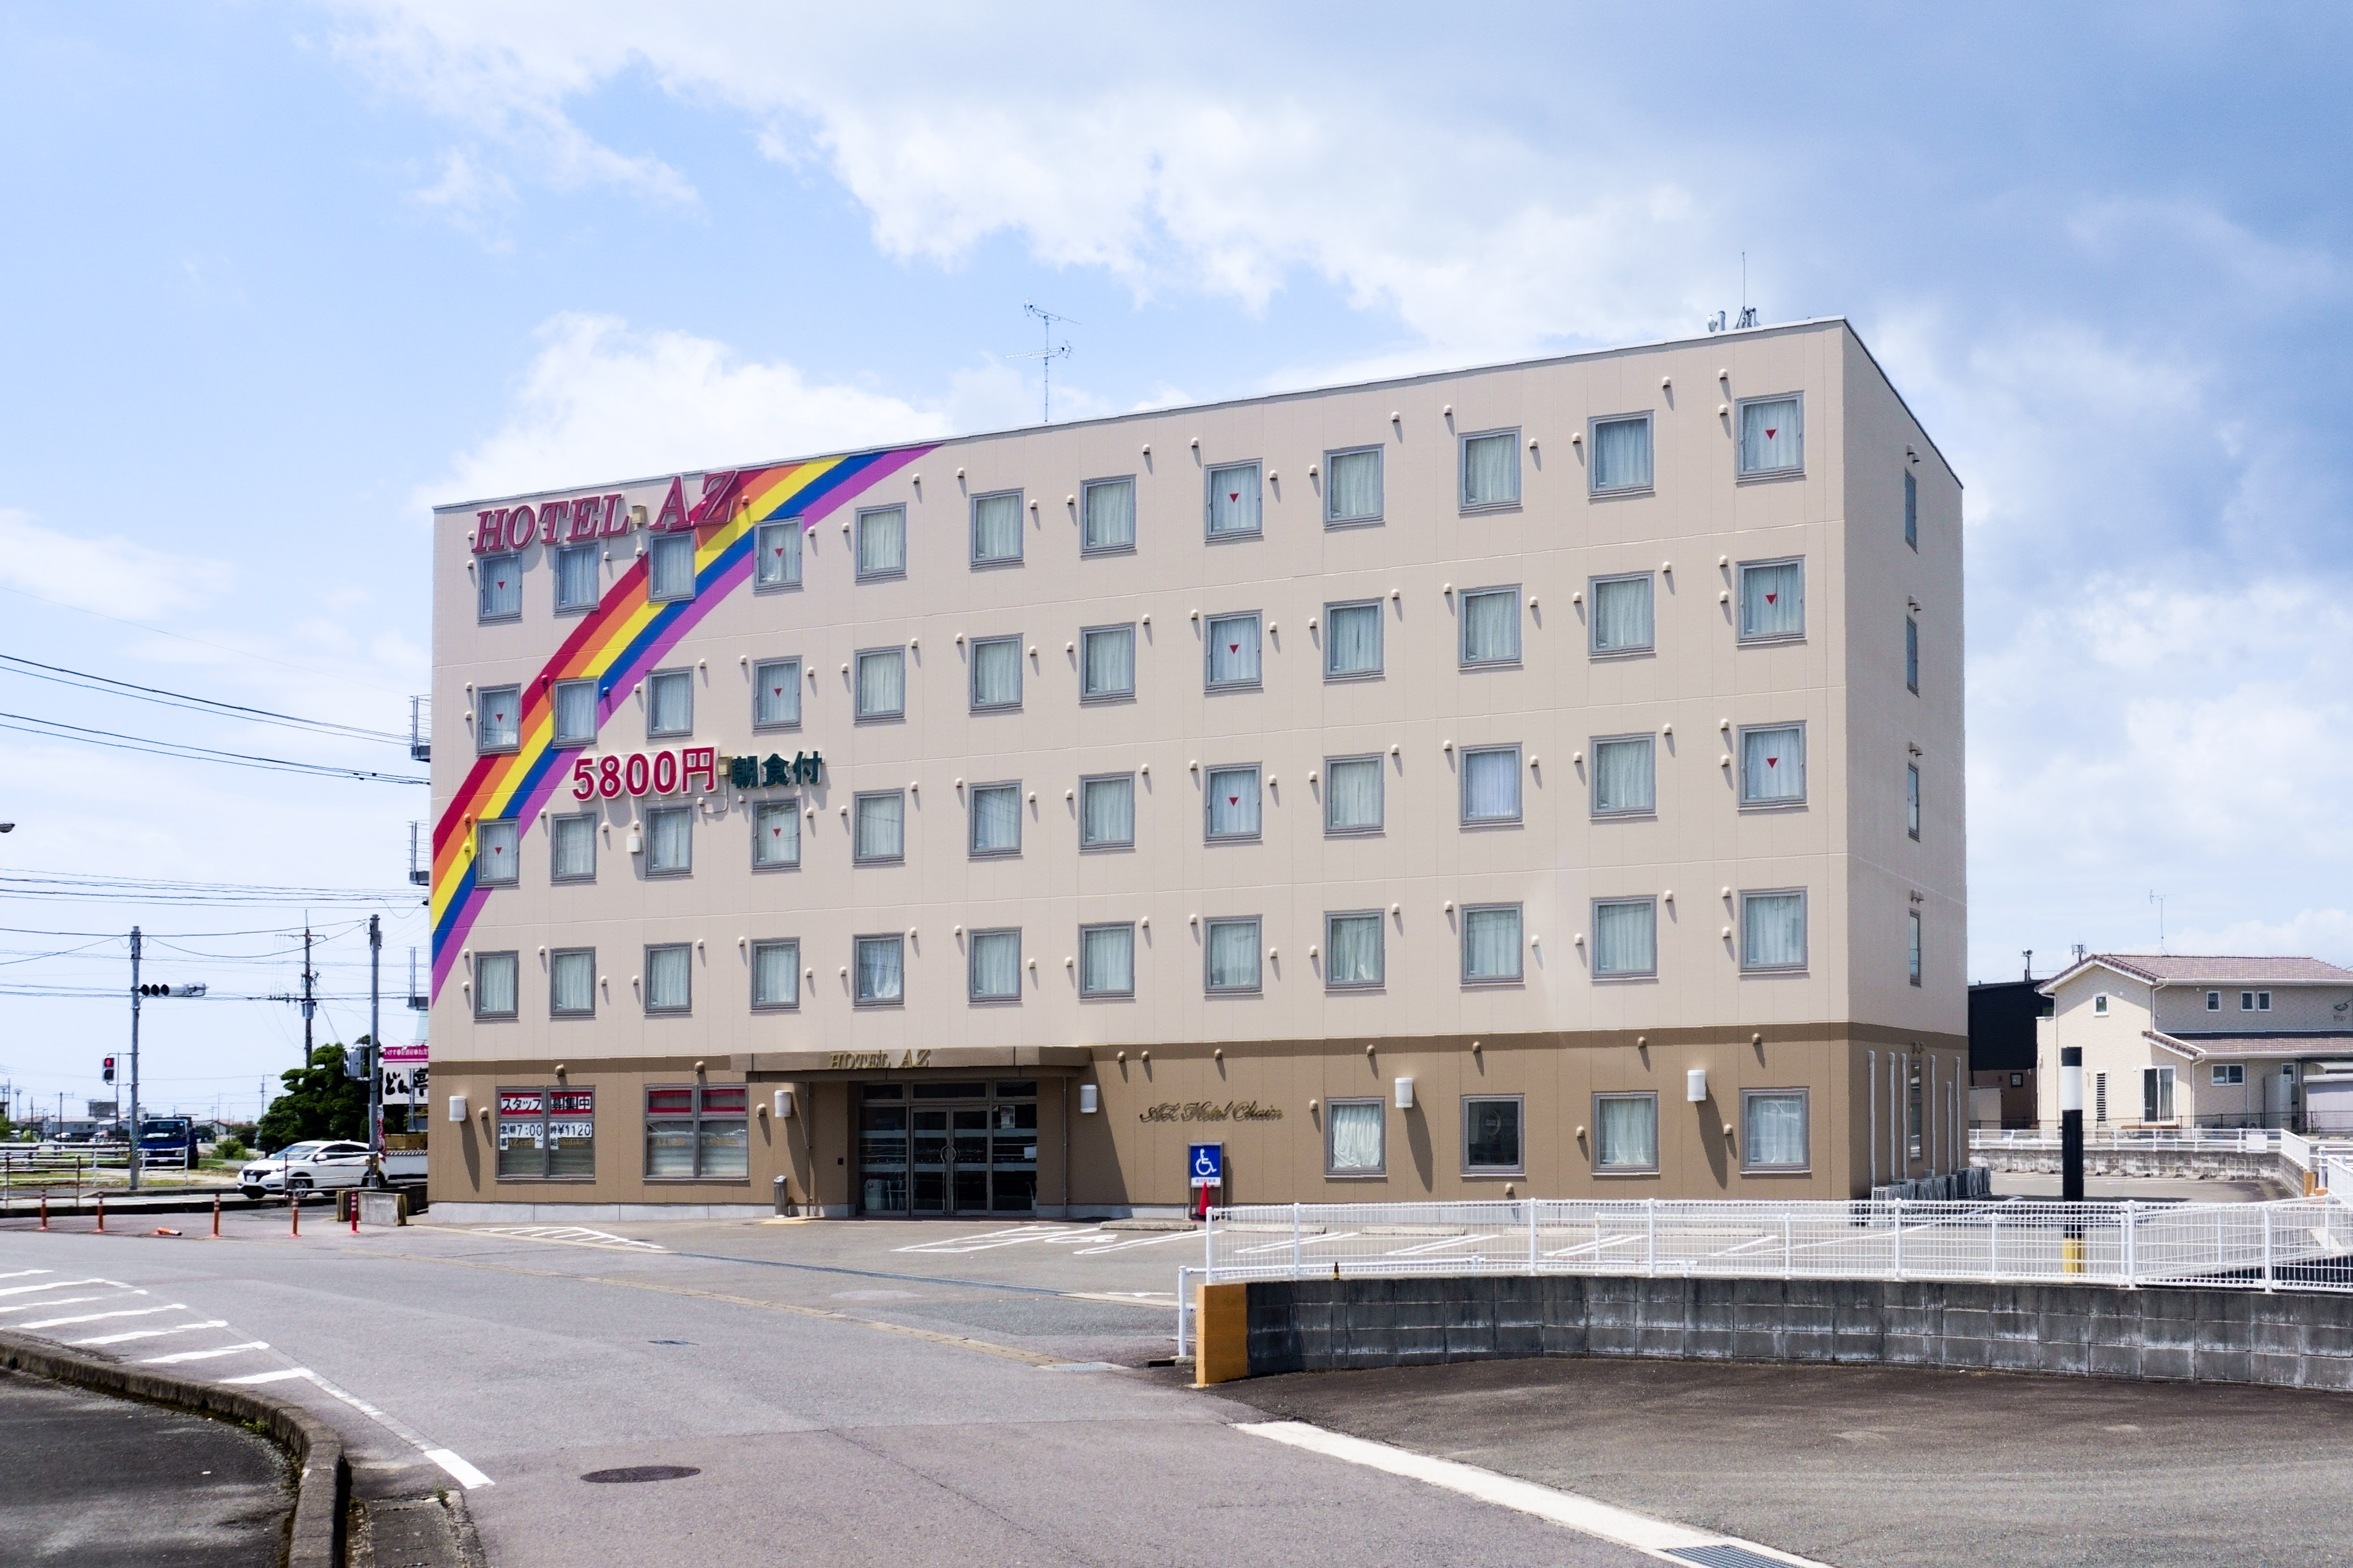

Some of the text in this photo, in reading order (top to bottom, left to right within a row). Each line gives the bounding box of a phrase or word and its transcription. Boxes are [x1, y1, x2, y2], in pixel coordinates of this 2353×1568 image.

[471, 471, 737, 553] HOTEL AZ
[572, 746, 716, 801] 5800円
[731, 751, 823, 789] 朝食付
[829, 1049, 932, 1070] HOTEL AZ
[502, 1098, 541, 1110] スタッフ
[550, 1096, 591, 1110] 募集中
[1139, 1100, 1284, 1123] AZ Hotel Chain
